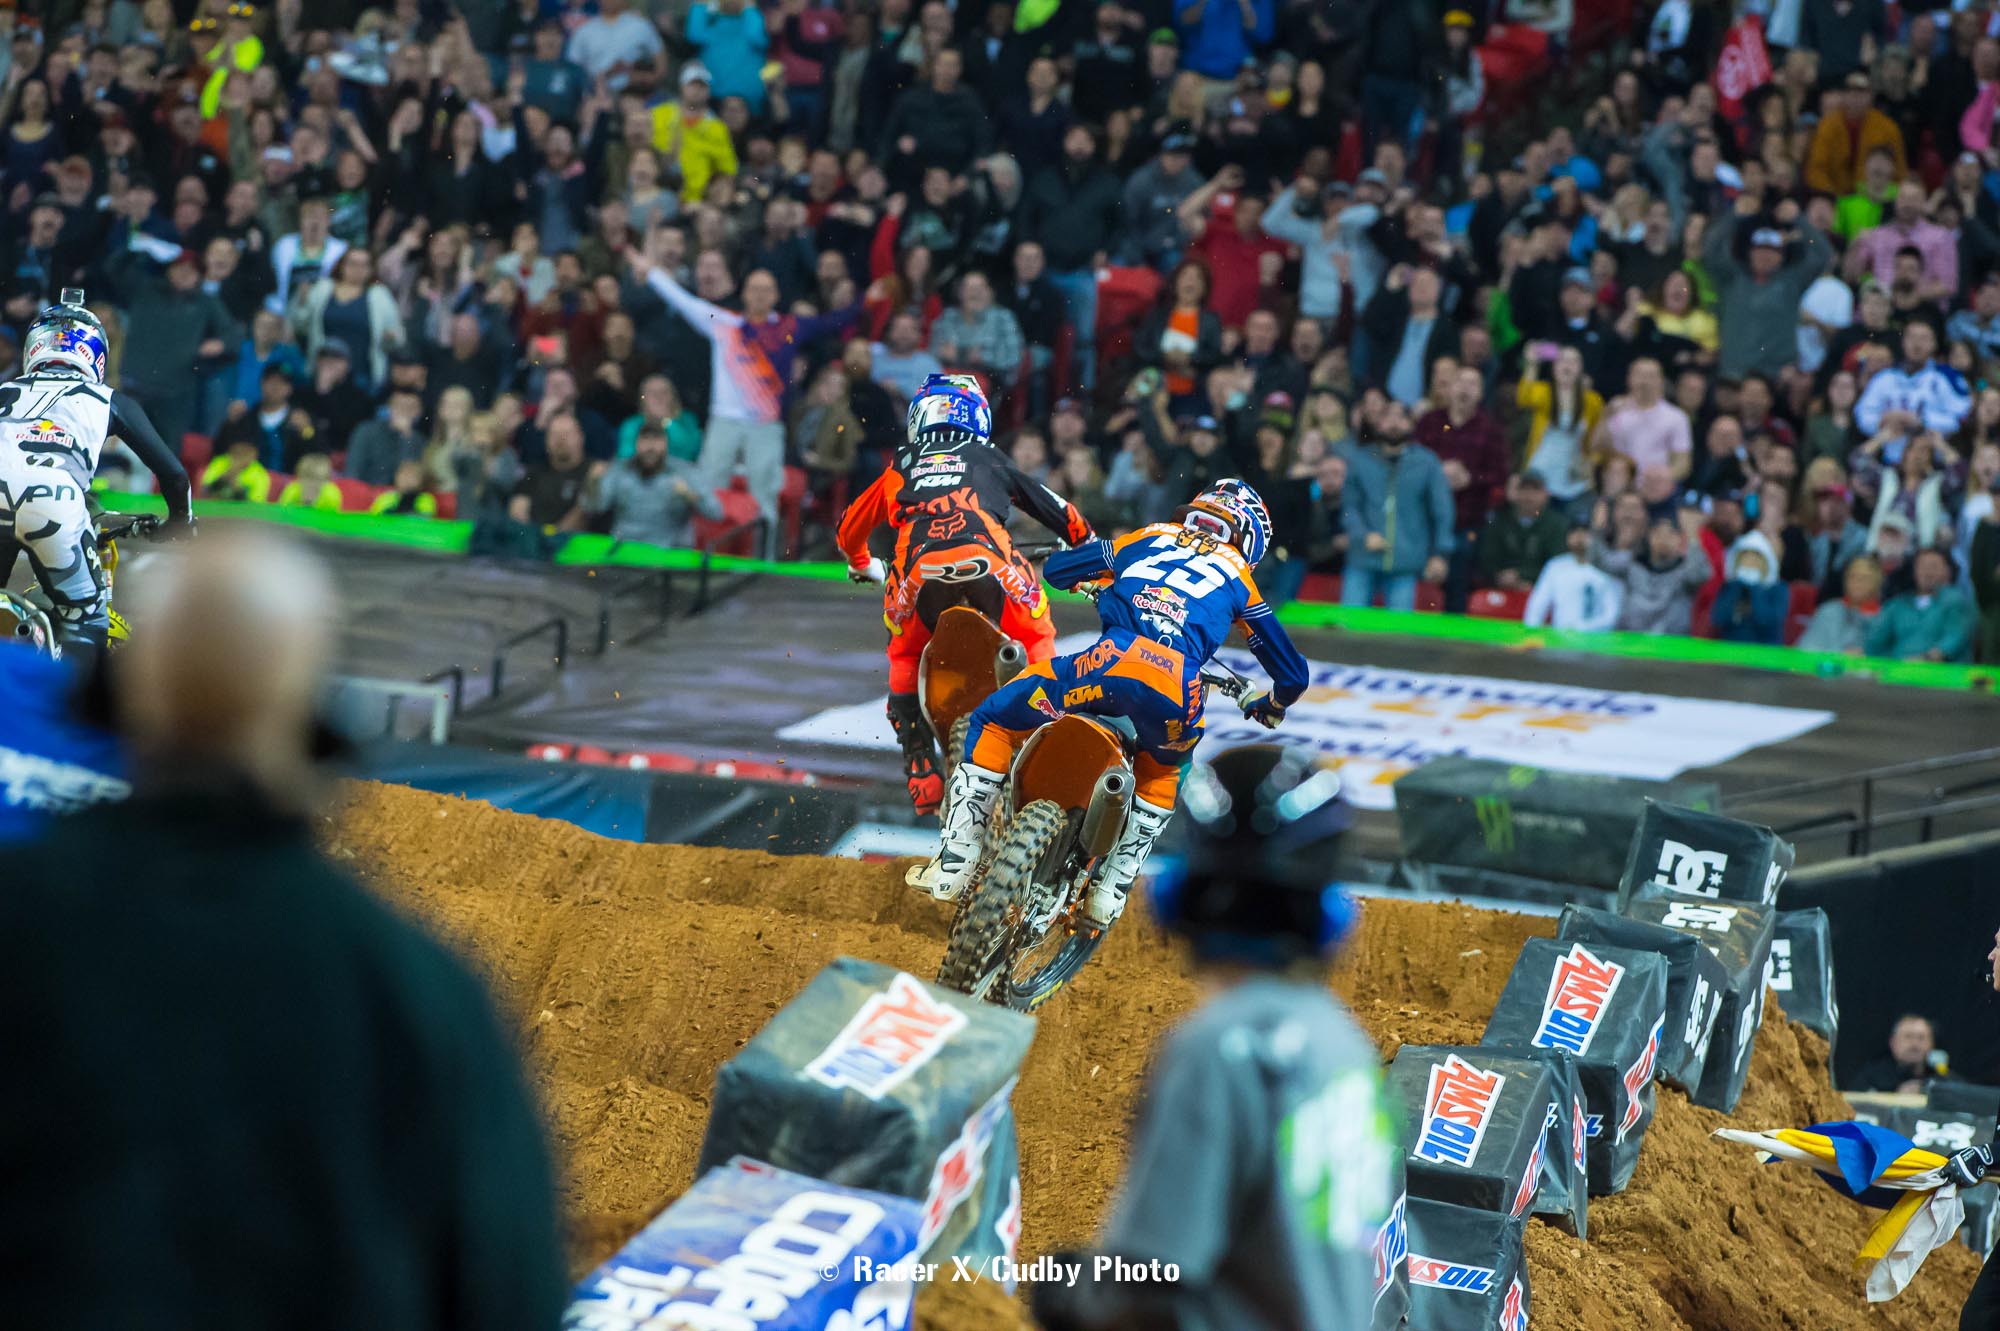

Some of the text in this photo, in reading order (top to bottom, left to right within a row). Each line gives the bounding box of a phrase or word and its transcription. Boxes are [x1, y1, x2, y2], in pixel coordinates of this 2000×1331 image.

[30, 342, 42, 357] BELL
[77, 344, 92, 361] BELL
[16, 433, 73, 446] Red Bull
[911, 463, 966, 479] Red Bull
[913, 475, 962, 491] KTM
[1120, 534, 1241, 599] 25
[1133, 595, 1185, 622] Red Bull
[1074, 639, 1125, 679] THOR
[1140, 647, 1174, 674] THOR
[1064, 684, 1103, 707] KTM
[1655, 840, 1728, 898] DC
[1536, 949, 1618, 1053] AMSOIL
[1419, 1060, 1499, 1164] AMSOIL
